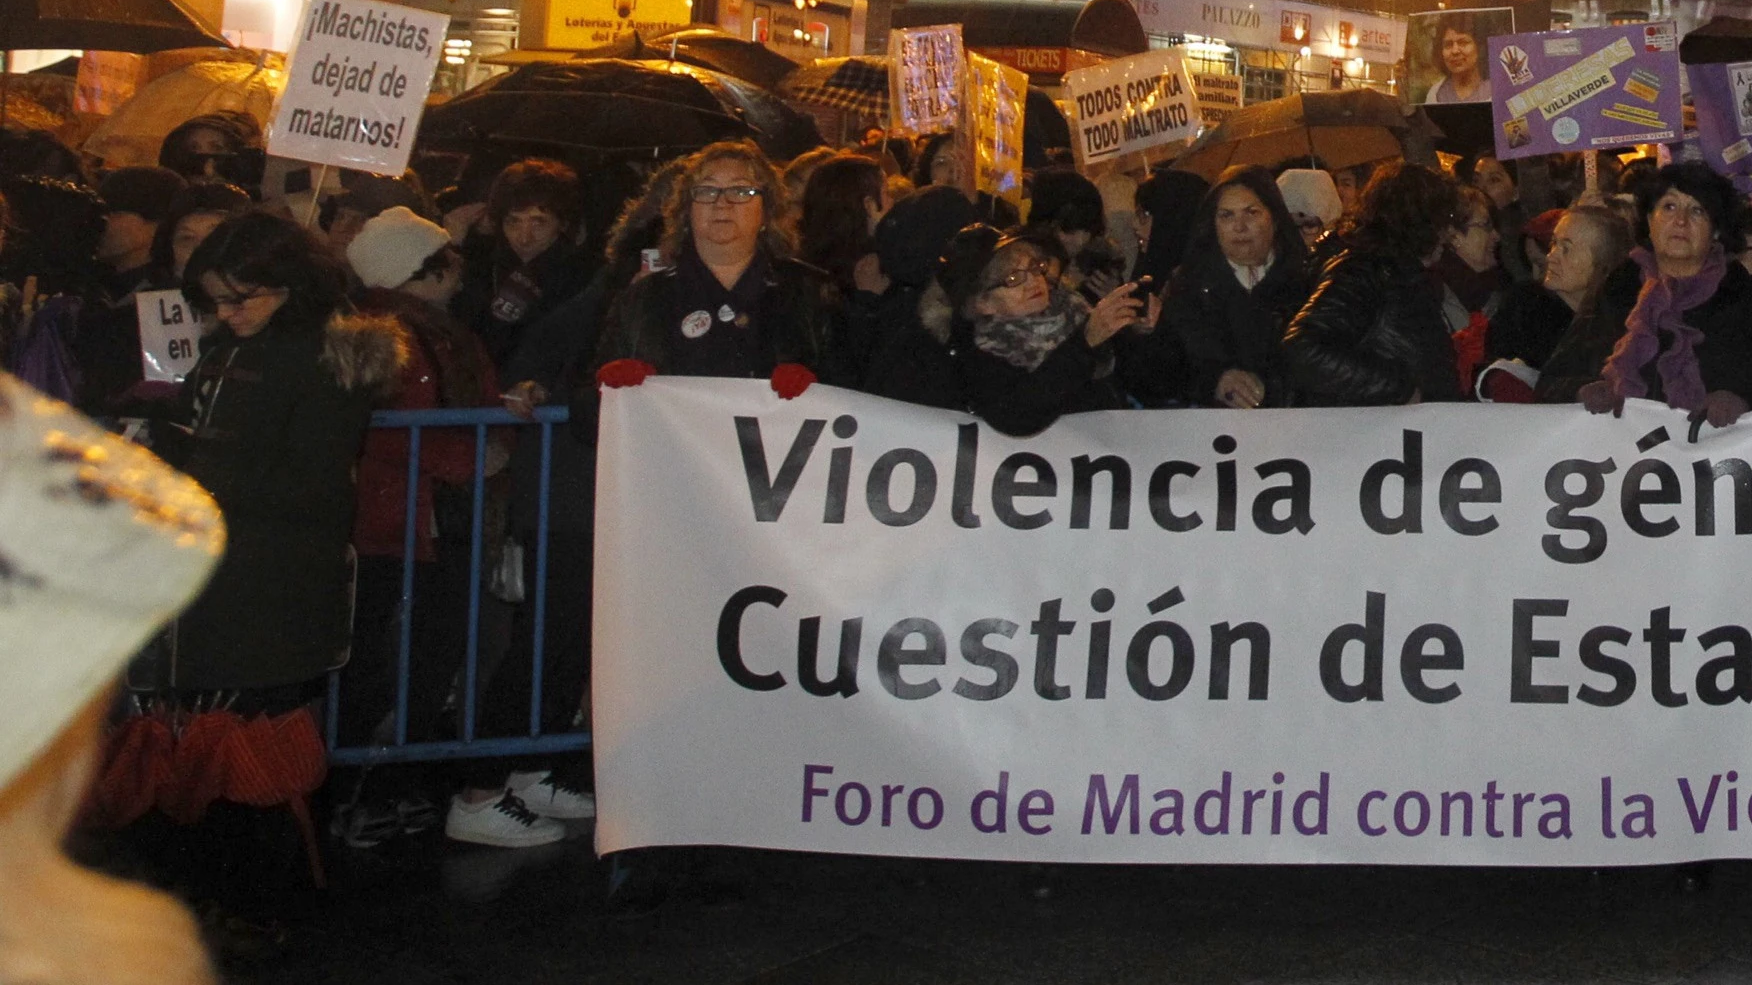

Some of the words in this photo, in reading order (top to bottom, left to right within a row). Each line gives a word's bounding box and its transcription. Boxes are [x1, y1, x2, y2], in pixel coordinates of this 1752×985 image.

[306, 1, 433, 59] ¡Machistas,
[1202, 2, 1260, 30] PALAZZO
[1361, 29, 1392, 45] artec
[311, 53, 377, 97] dejad
[379, 65, 408, 99] de
[1016, 49, 1061, 68] TICKETS
[1076, 84, 1122, 120] TODOS
[1127, 72, 1183, 107] CONTRA
[1197, 91, 1239, 107] amiliar,
[1543, 74, 1611, 115] VILLAVERDE
[288, 106, 406, 149] matarnos!
[1084, 119, 1119, 153] TODO
[1122, 102, 1188, 142] MALTRATO
[158, 298, 183, 326] La
[168, 337, 192, 360] en
[733, 415, 1316, 536] Violencia
[1359, 429, 1502, 536] de
[716, 585, 1271, 701] Cuestión
[1319, 590, 1464, 704] de
[800, 764, 944, 831] Foro
[971, 771, 1055, 835] de
[1081, 771, 1330, 836] Madrid
[1356, 781, 1573, 839] contra
[1600, 776, 1657, 839] la
